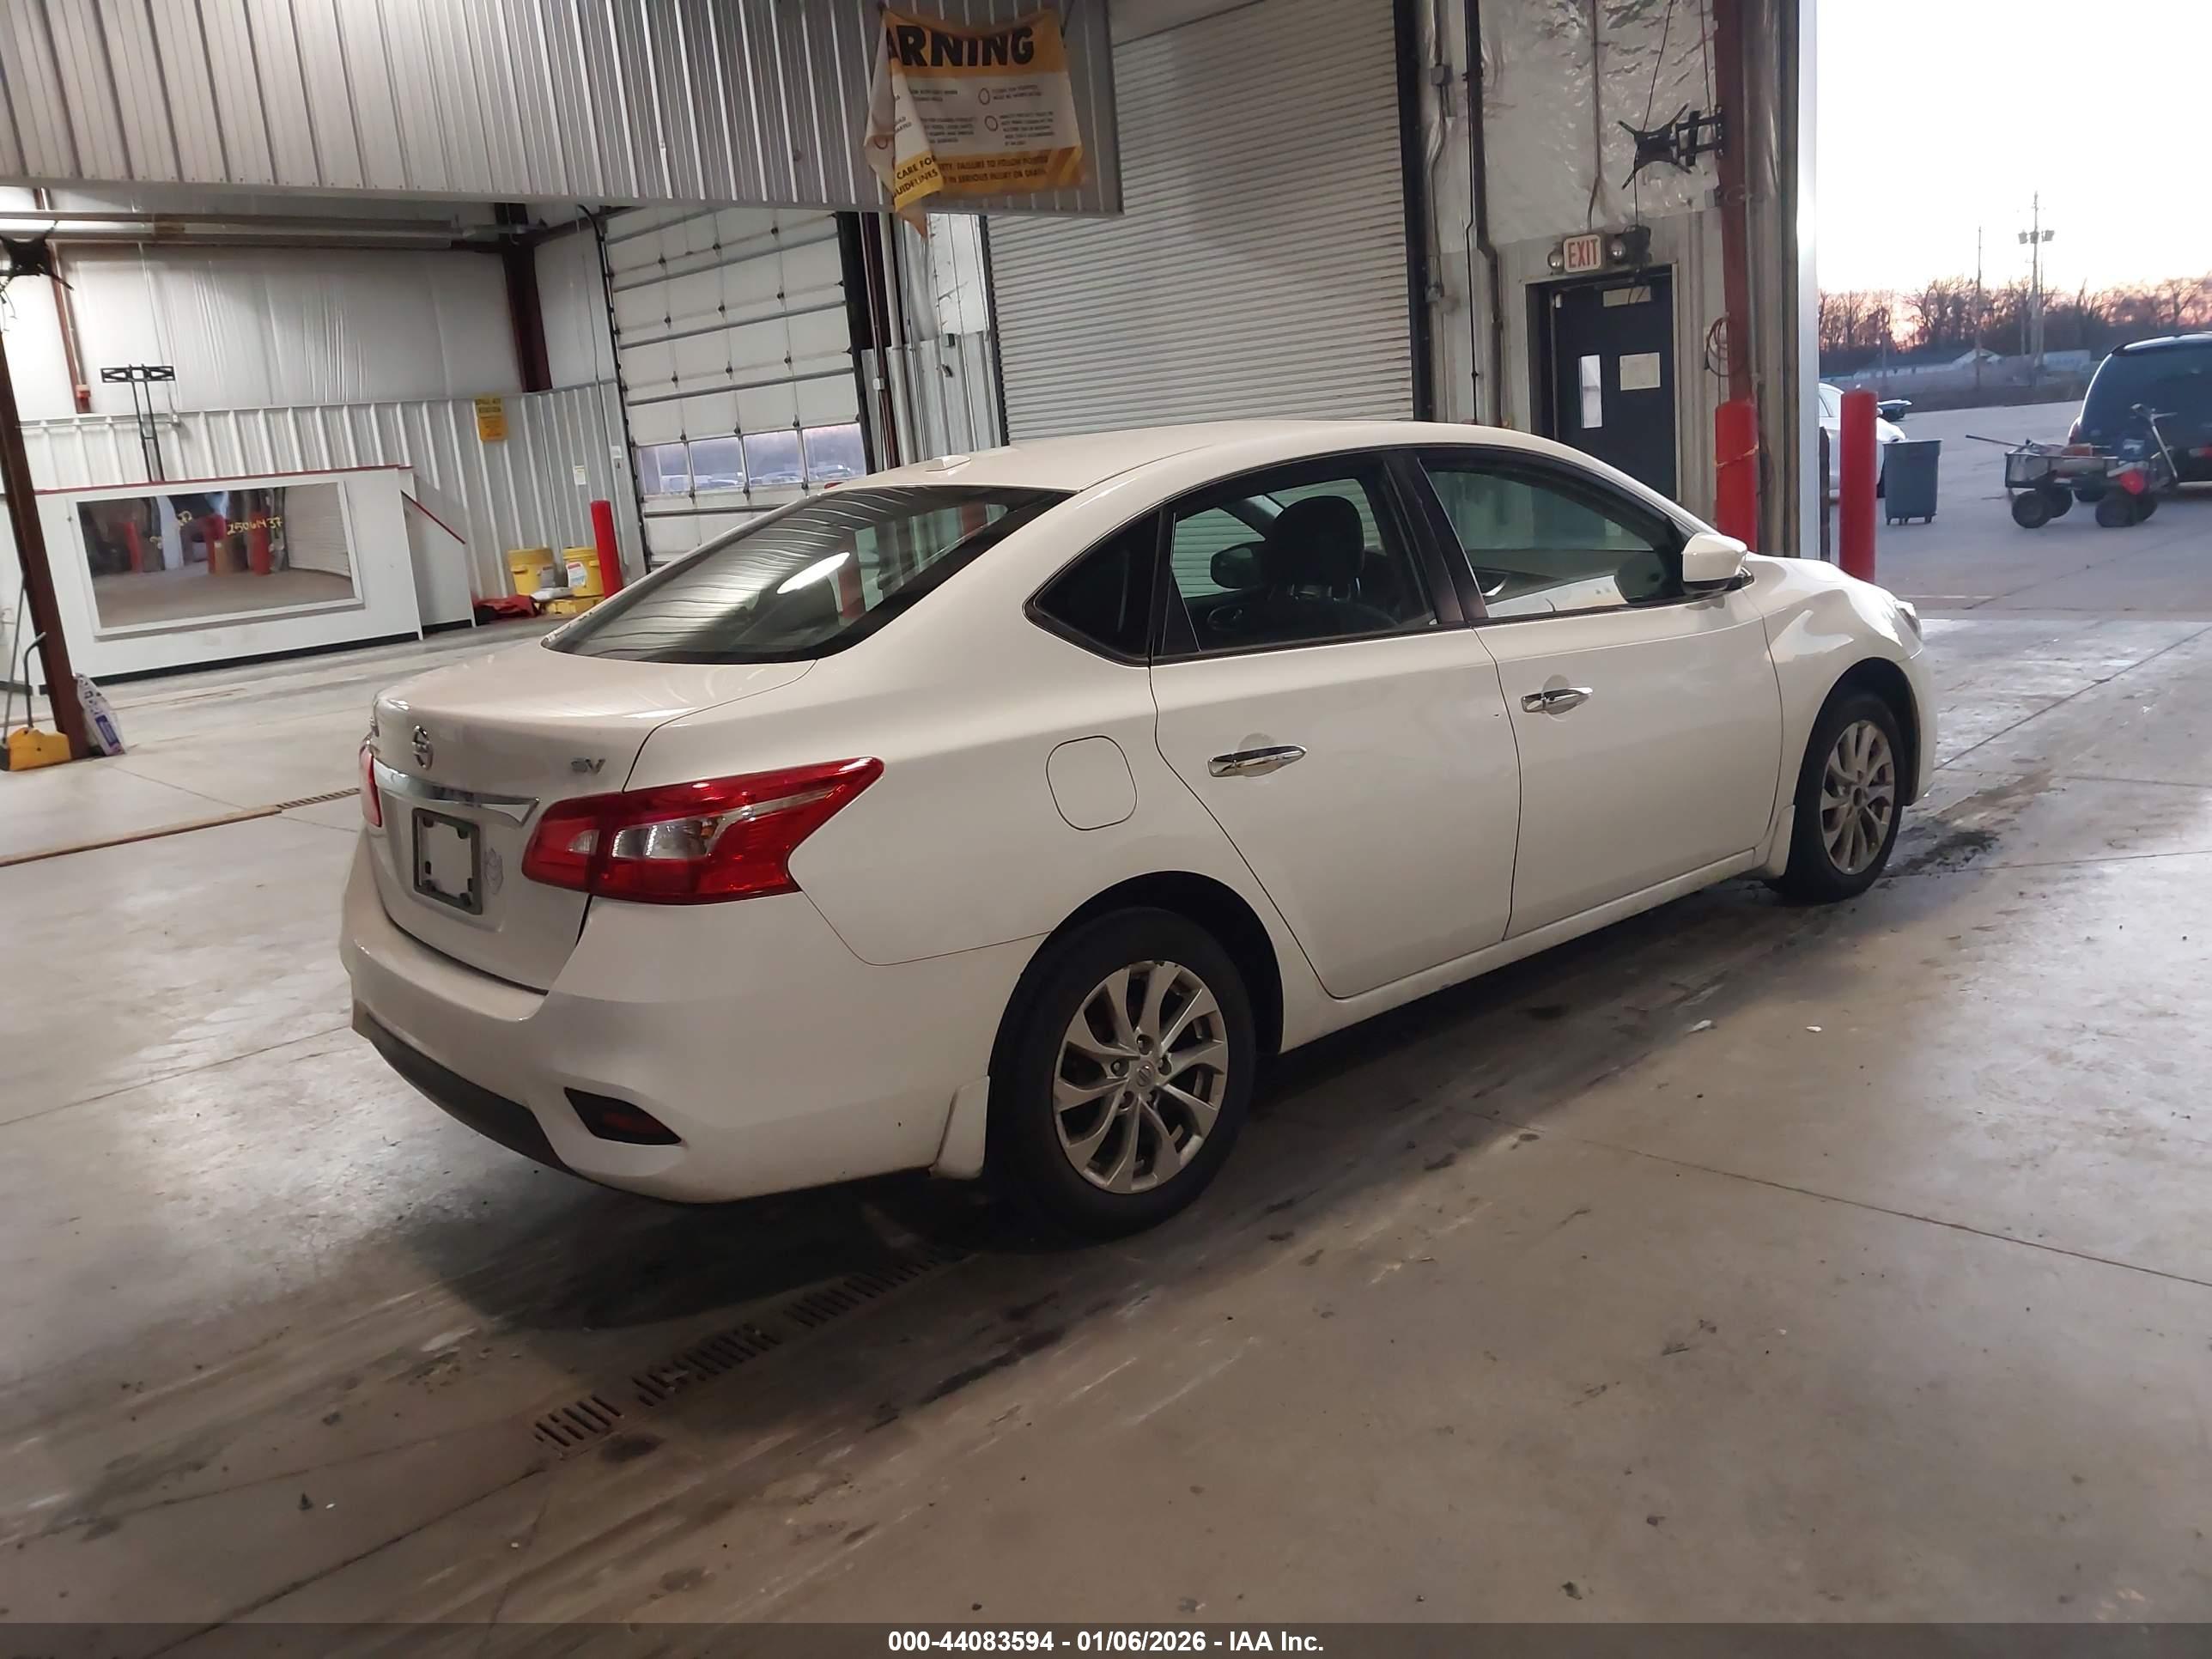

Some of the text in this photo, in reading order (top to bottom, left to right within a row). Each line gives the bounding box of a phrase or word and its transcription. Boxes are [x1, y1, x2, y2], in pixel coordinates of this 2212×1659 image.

[896, 163, 919, 179] CARE
[1568, 238, 1599, 269] EXIT
[570, 756, 606, 775] SV
